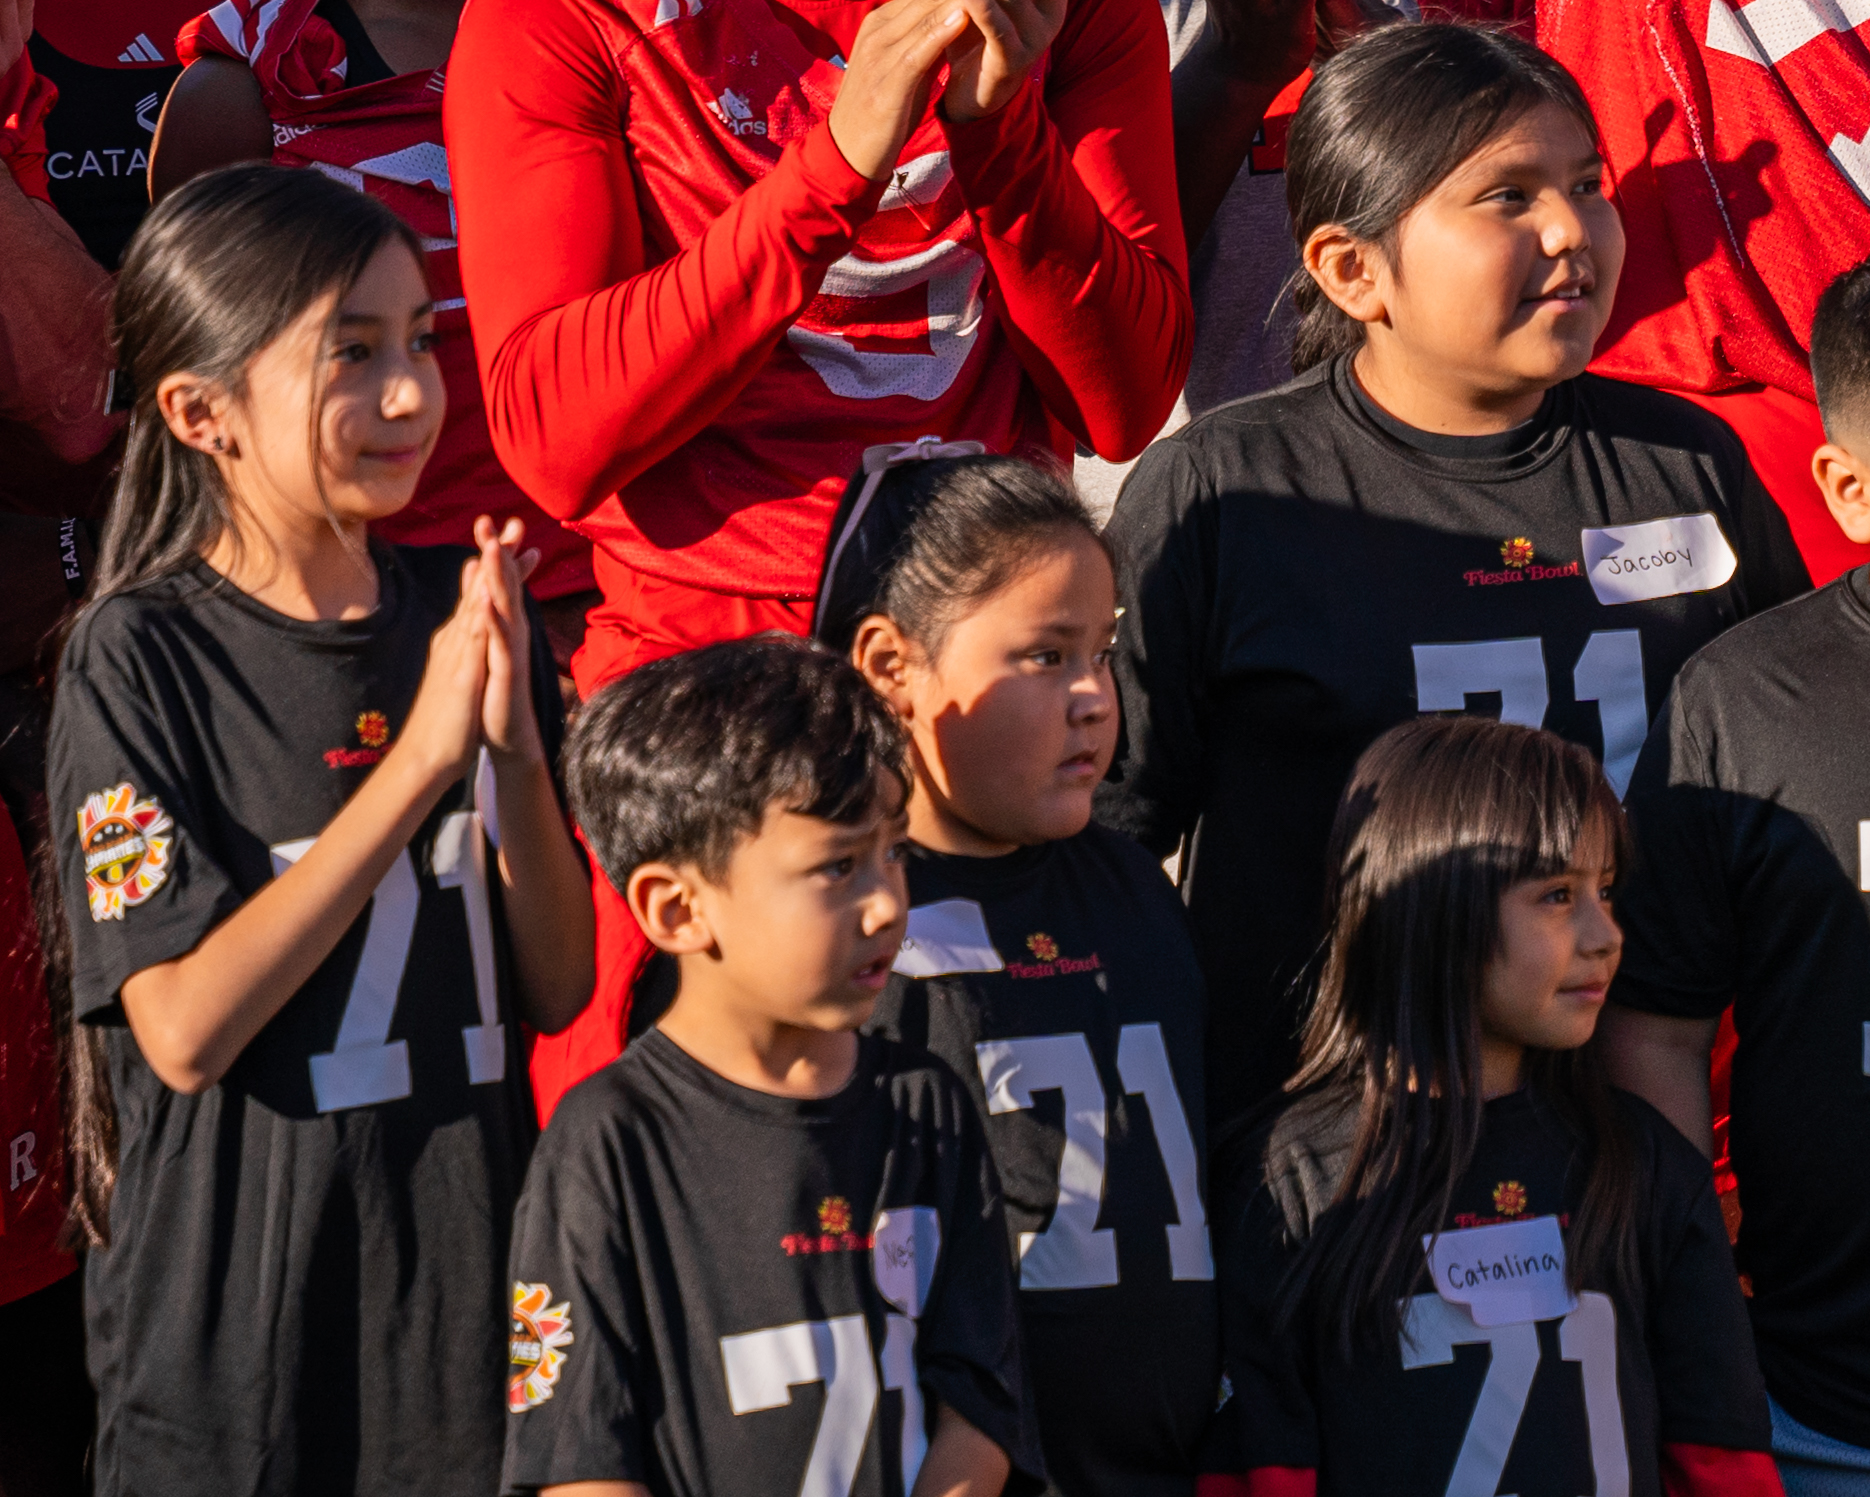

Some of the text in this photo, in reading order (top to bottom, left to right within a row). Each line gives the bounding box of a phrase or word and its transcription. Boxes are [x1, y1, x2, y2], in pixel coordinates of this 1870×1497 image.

[1463, 561, 1581, 587] Fiesta Bowl
[1601, 547, 1694, 575] Jacoby
[976, 1022, 1216, 1292] 71
[1447, 1253, 1560, 1290] Catalina
[1399, 1291, 1631, 1497] 71
